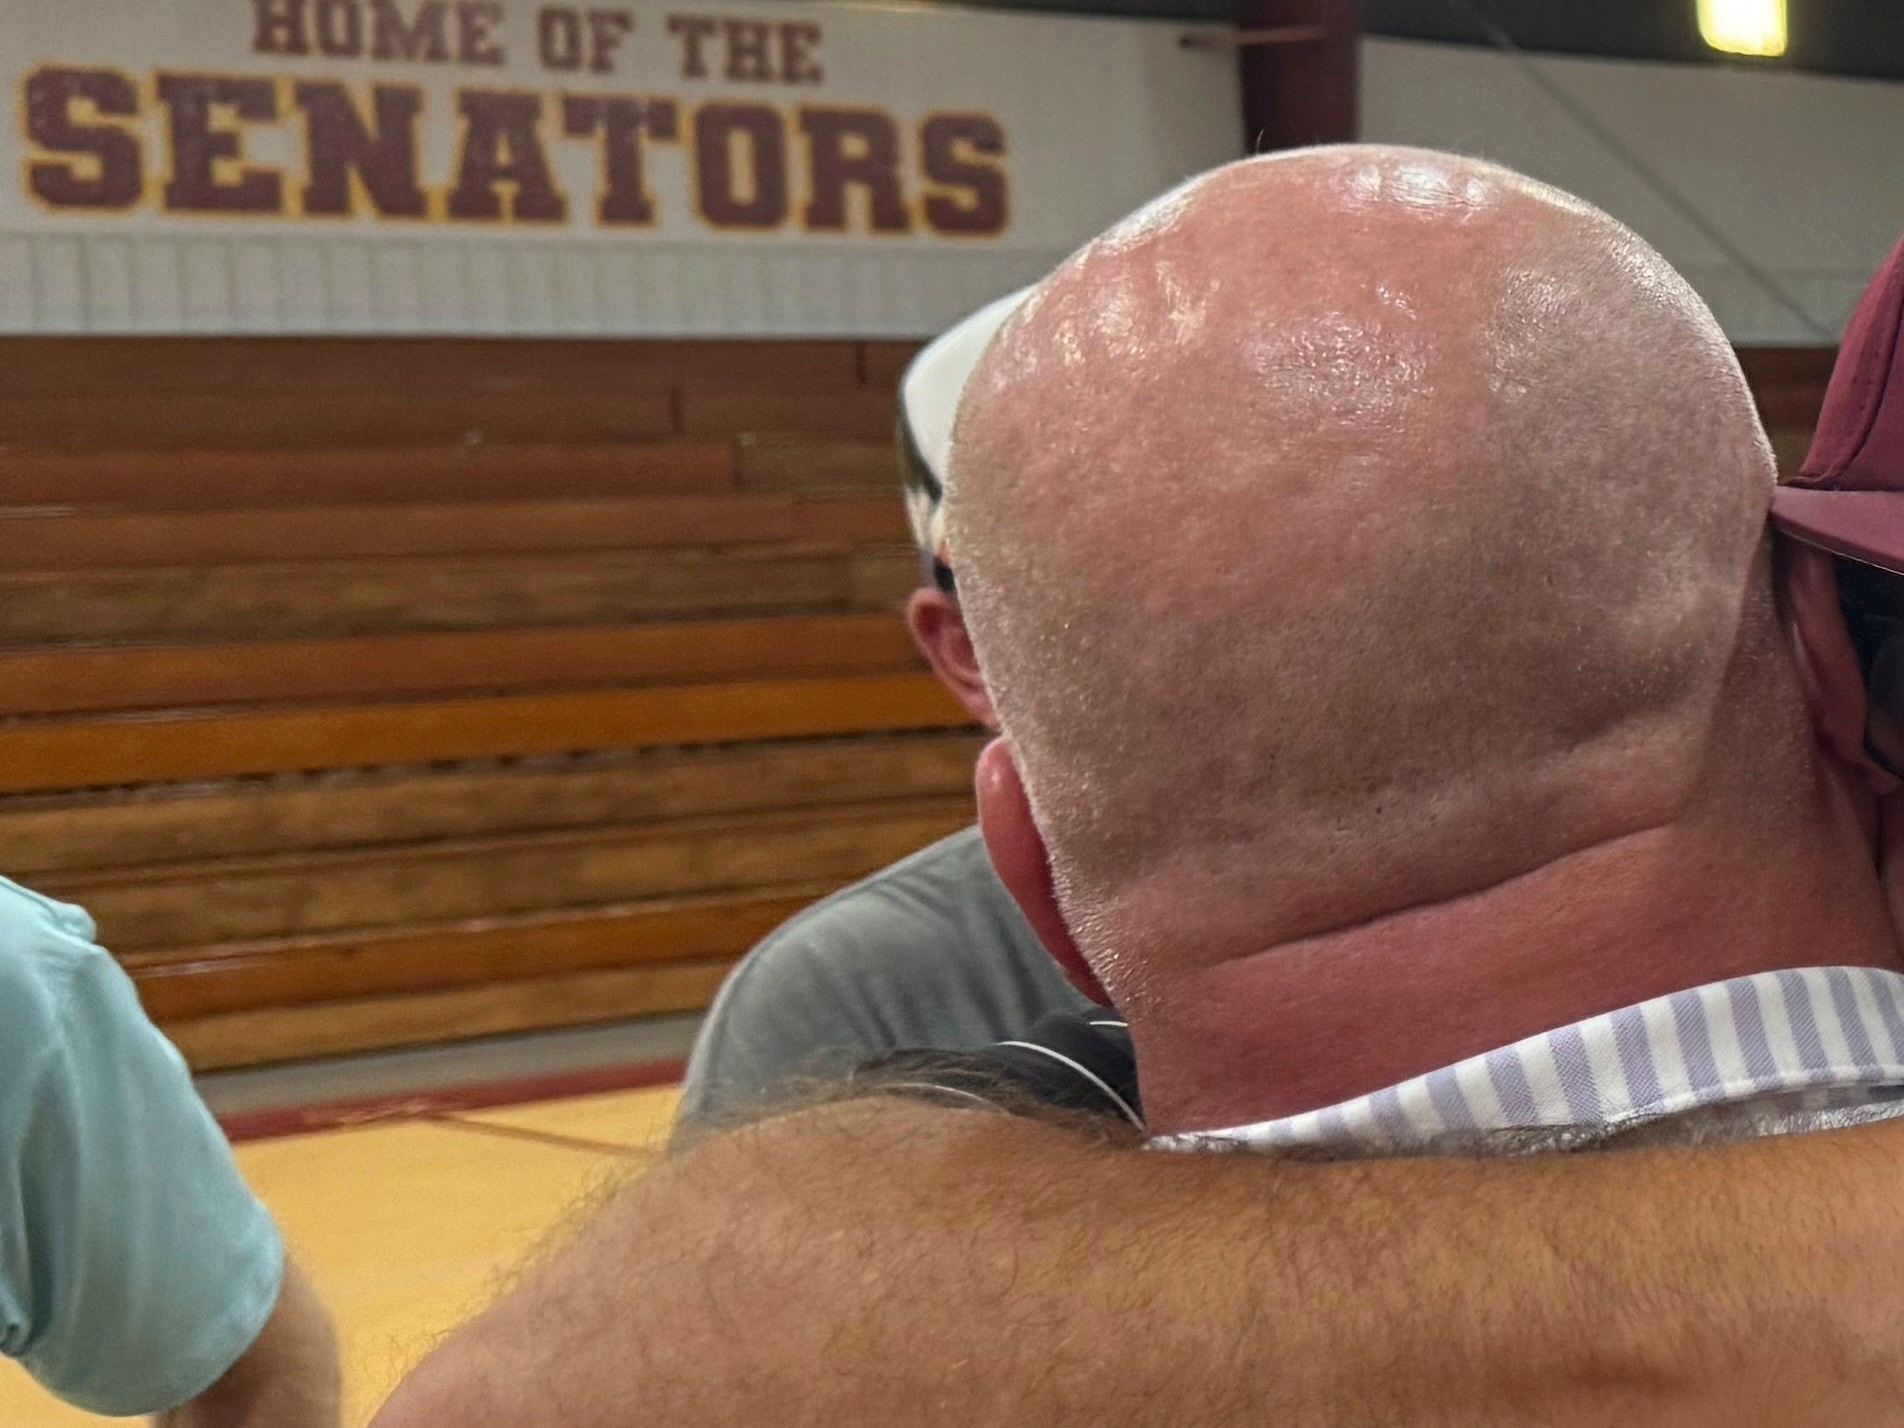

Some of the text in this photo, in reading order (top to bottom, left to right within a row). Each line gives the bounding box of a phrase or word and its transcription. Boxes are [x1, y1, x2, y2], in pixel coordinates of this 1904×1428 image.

[537, 3, 635, 75] OF
[667, 14, 824, 86] THE
[19, 60, 1013, 238] SENATORS
